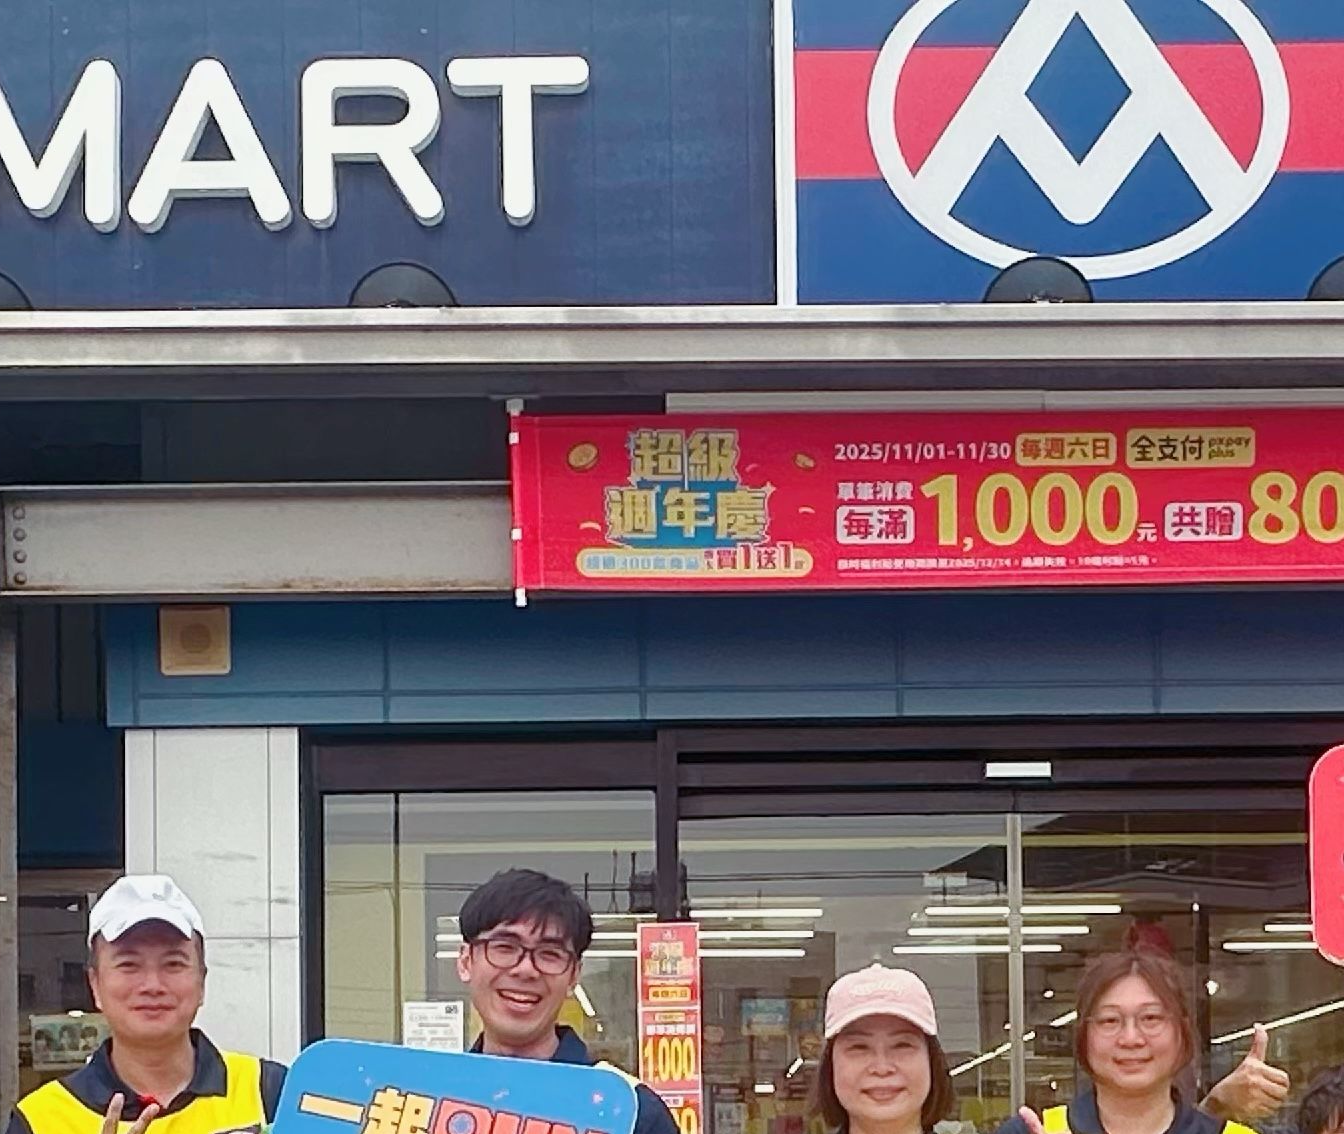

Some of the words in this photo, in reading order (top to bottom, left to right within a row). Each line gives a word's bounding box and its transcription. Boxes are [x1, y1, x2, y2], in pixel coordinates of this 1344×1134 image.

[631, 428, 739, 482] 超級
[834, 441, 1012, 463] 2025/11/01-11/30
[1020, 437, 1111, 462] 每週六日
[1131, 434, 1205, 462] 全支付
[607, 486, 770, 540] 週年慶
[843, 507, 909, 540] 每滿
[920, 472, 1139, 553] 1,000
[1137, 522, 1158, 543] 元
[1170, 506, 1236, 537] 共贈
